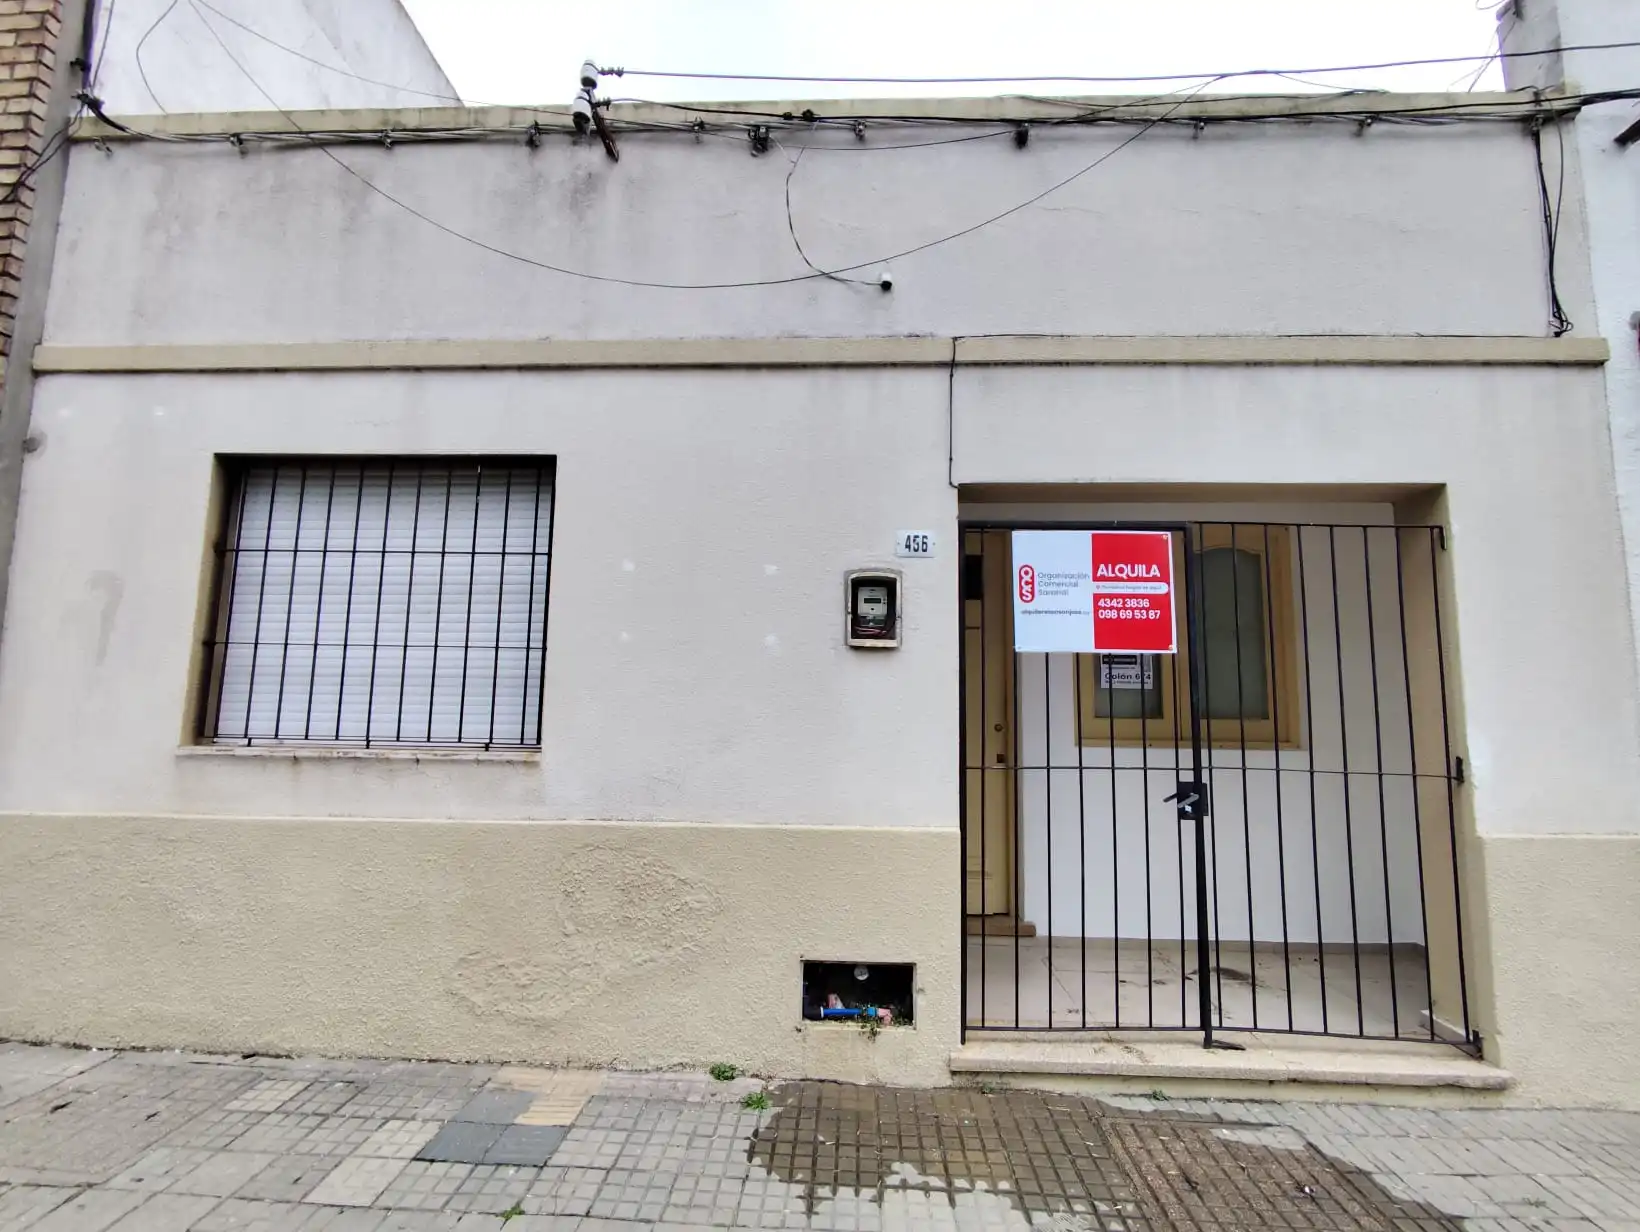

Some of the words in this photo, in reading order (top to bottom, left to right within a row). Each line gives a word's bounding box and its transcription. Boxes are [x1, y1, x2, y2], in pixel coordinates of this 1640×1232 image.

[904, 534, 929, 553] 456
[1037, 571, 1090, 581] Organización
[1096, 563, 1161, 580] ALQUILA
[1038, 580, 1079, 588] Comercial
[1097, 598, 1123, 608] 4342
[1124, 598, 1150, 608] 3836
[1098, 609, 1118, 619] 098
[1119, 609, 1133, 620] 69
[1133, 609, 1147, 620] 53
[1148, 609, 1161, 620] 87
